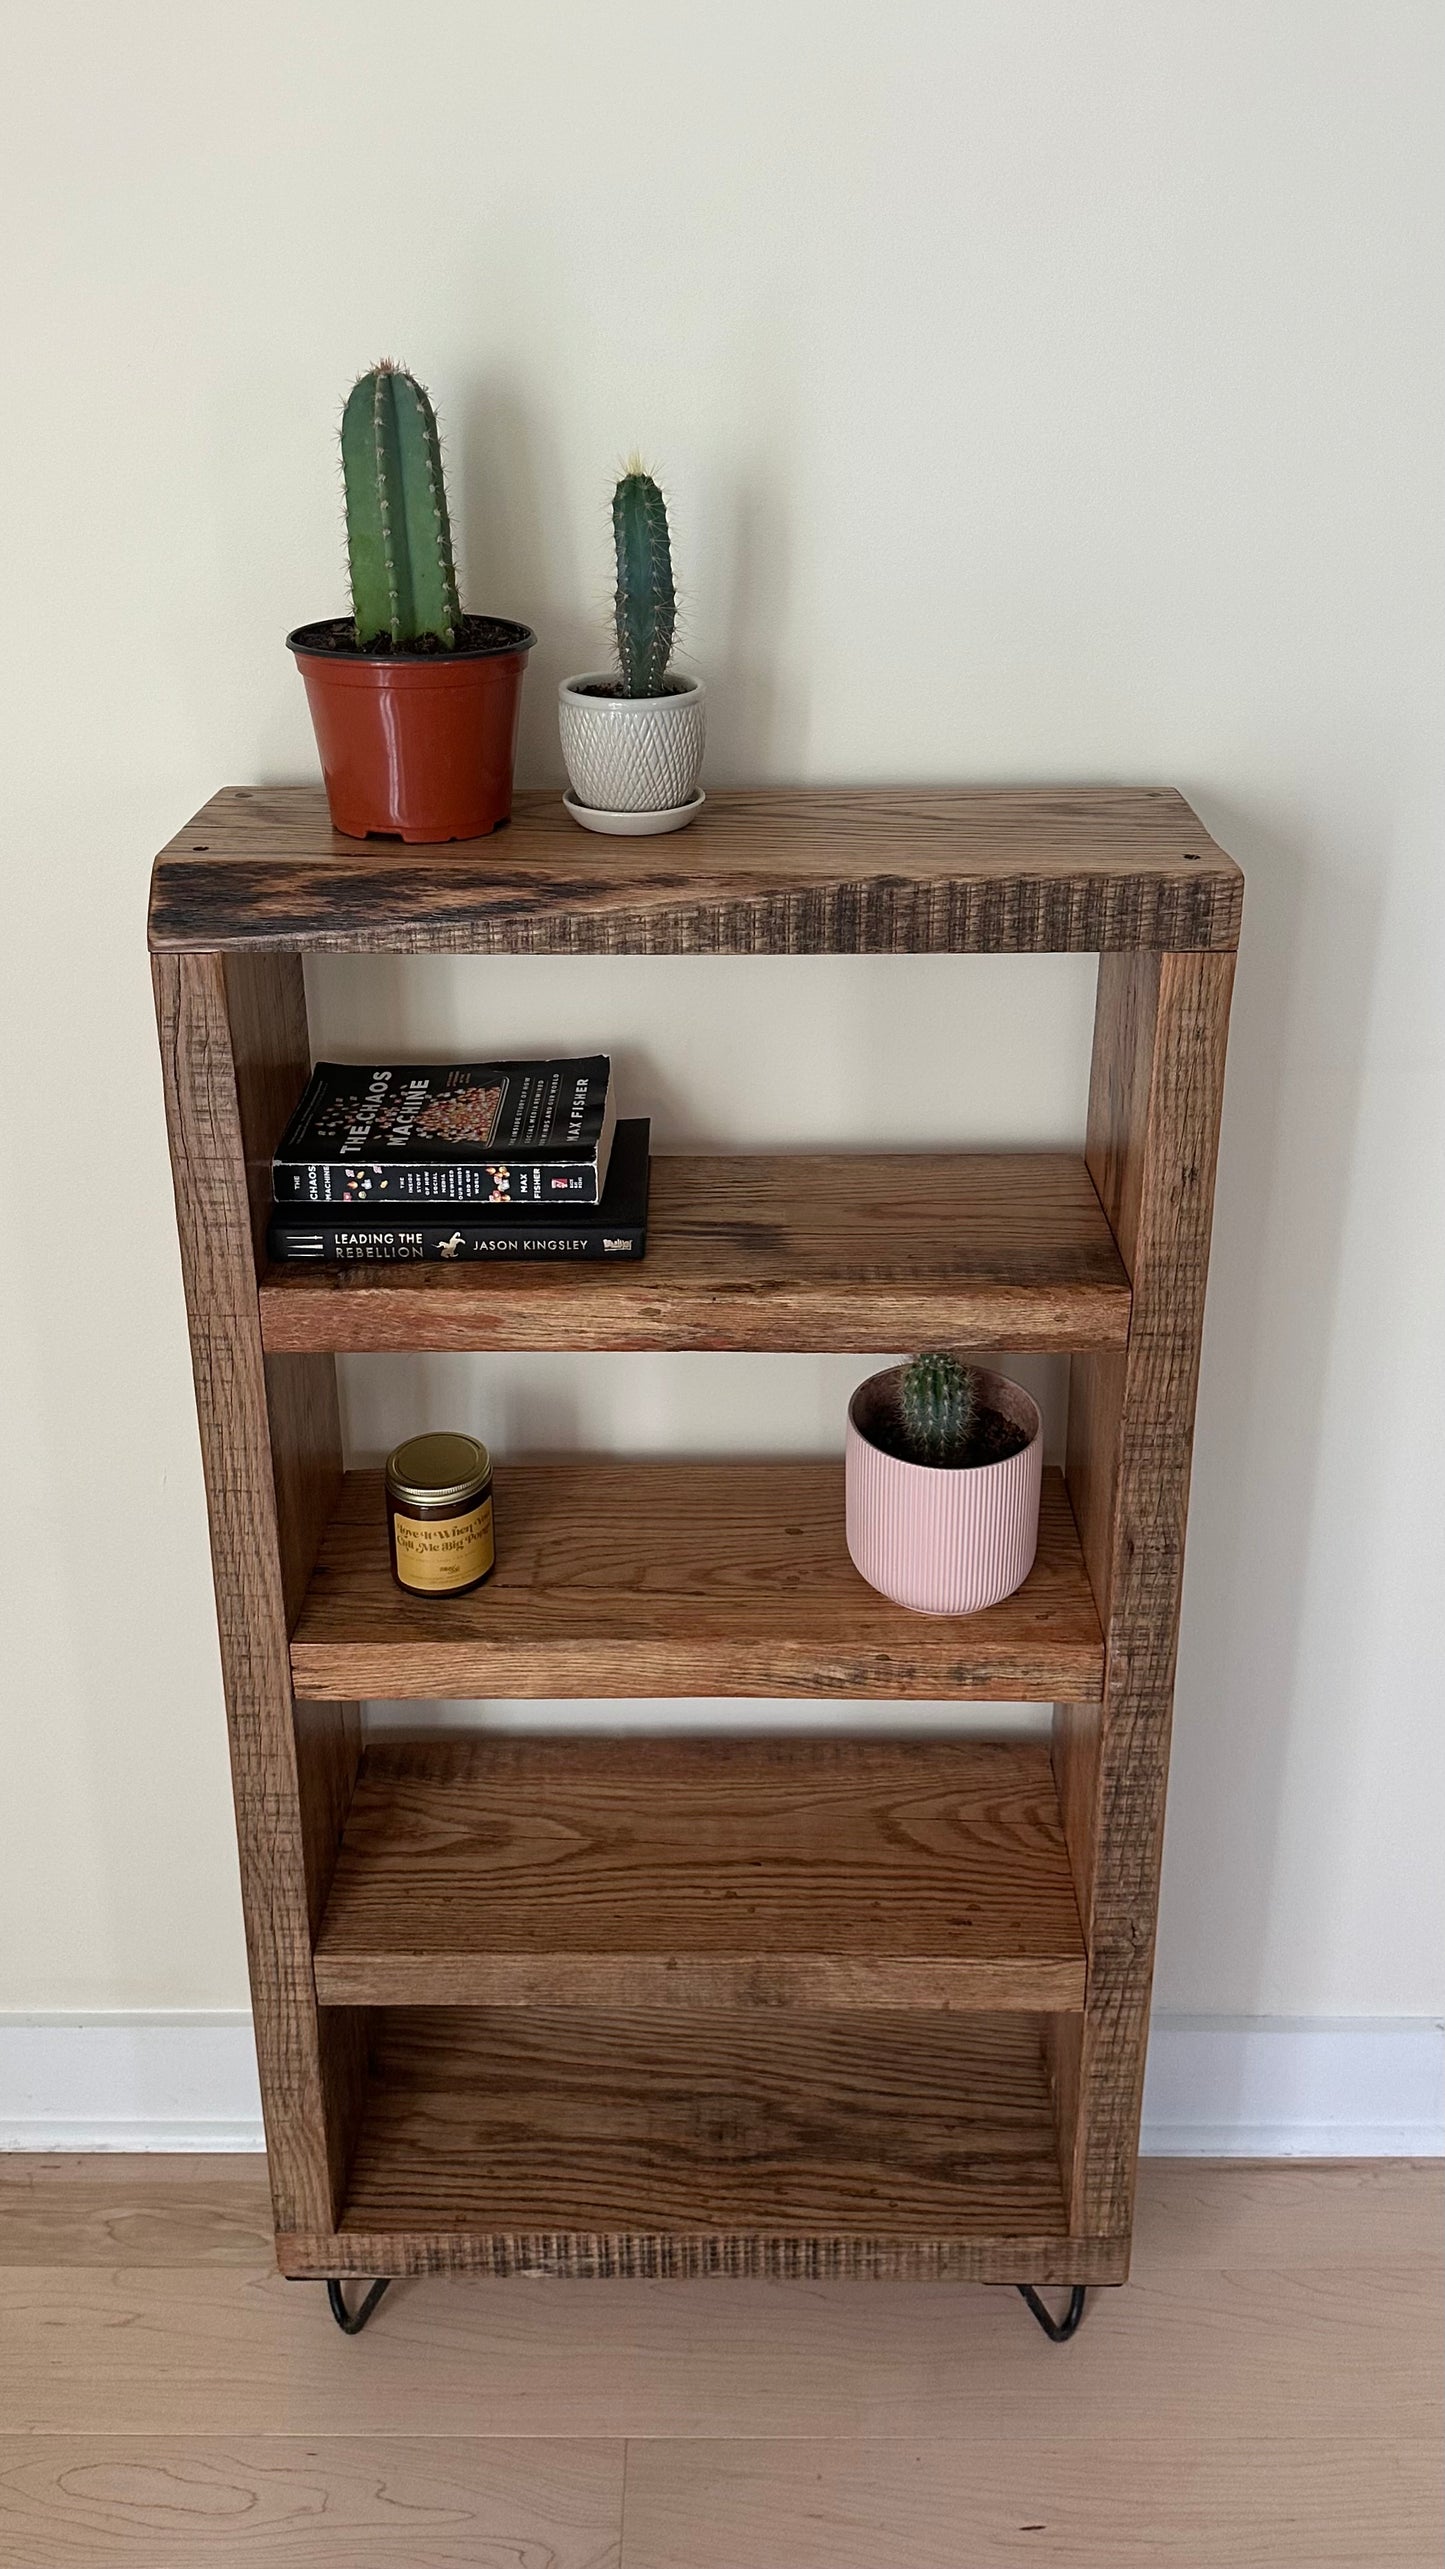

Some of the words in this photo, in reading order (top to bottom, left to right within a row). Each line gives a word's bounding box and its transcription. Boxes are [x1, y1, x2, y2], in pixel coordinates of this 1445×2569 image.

[545, 1106, 553, 1119] AND
[550, 1073, 560, 1094] WORLD
[571, 1078, 589, 1118] FISHER
[340, 1125, 371, 1154] THE
[356, 1071, 392, 1121] CHAOS
[386, 1080, 430, 1146] MACHINE
[529, 1105, 539, 1123] MEDIA
[566, 1122, 582, 1142] MAX
[308, 1166, 319, 1200] CHAOS
[323, 1166, 332, 1201] MACHINE
[424, 1186, 430, 1196] OF
[520, 1173, 528, 1193] MAX
[533, 1168, 541, 1199] FISHER
[334, 1233, 394, 1245] LEADING
[398, 1233, 423, 1244] THE
[473, 1239, 518, 1251] JASON
[523, 1239, 589, 1251] KINGSLEY
[336, 1246, 424, 1258] REBELLION
[434, 1524, 473, 1539] When
[416, 1542, 440, 1553] Me
[441, 1540, 464, 1552] Big
